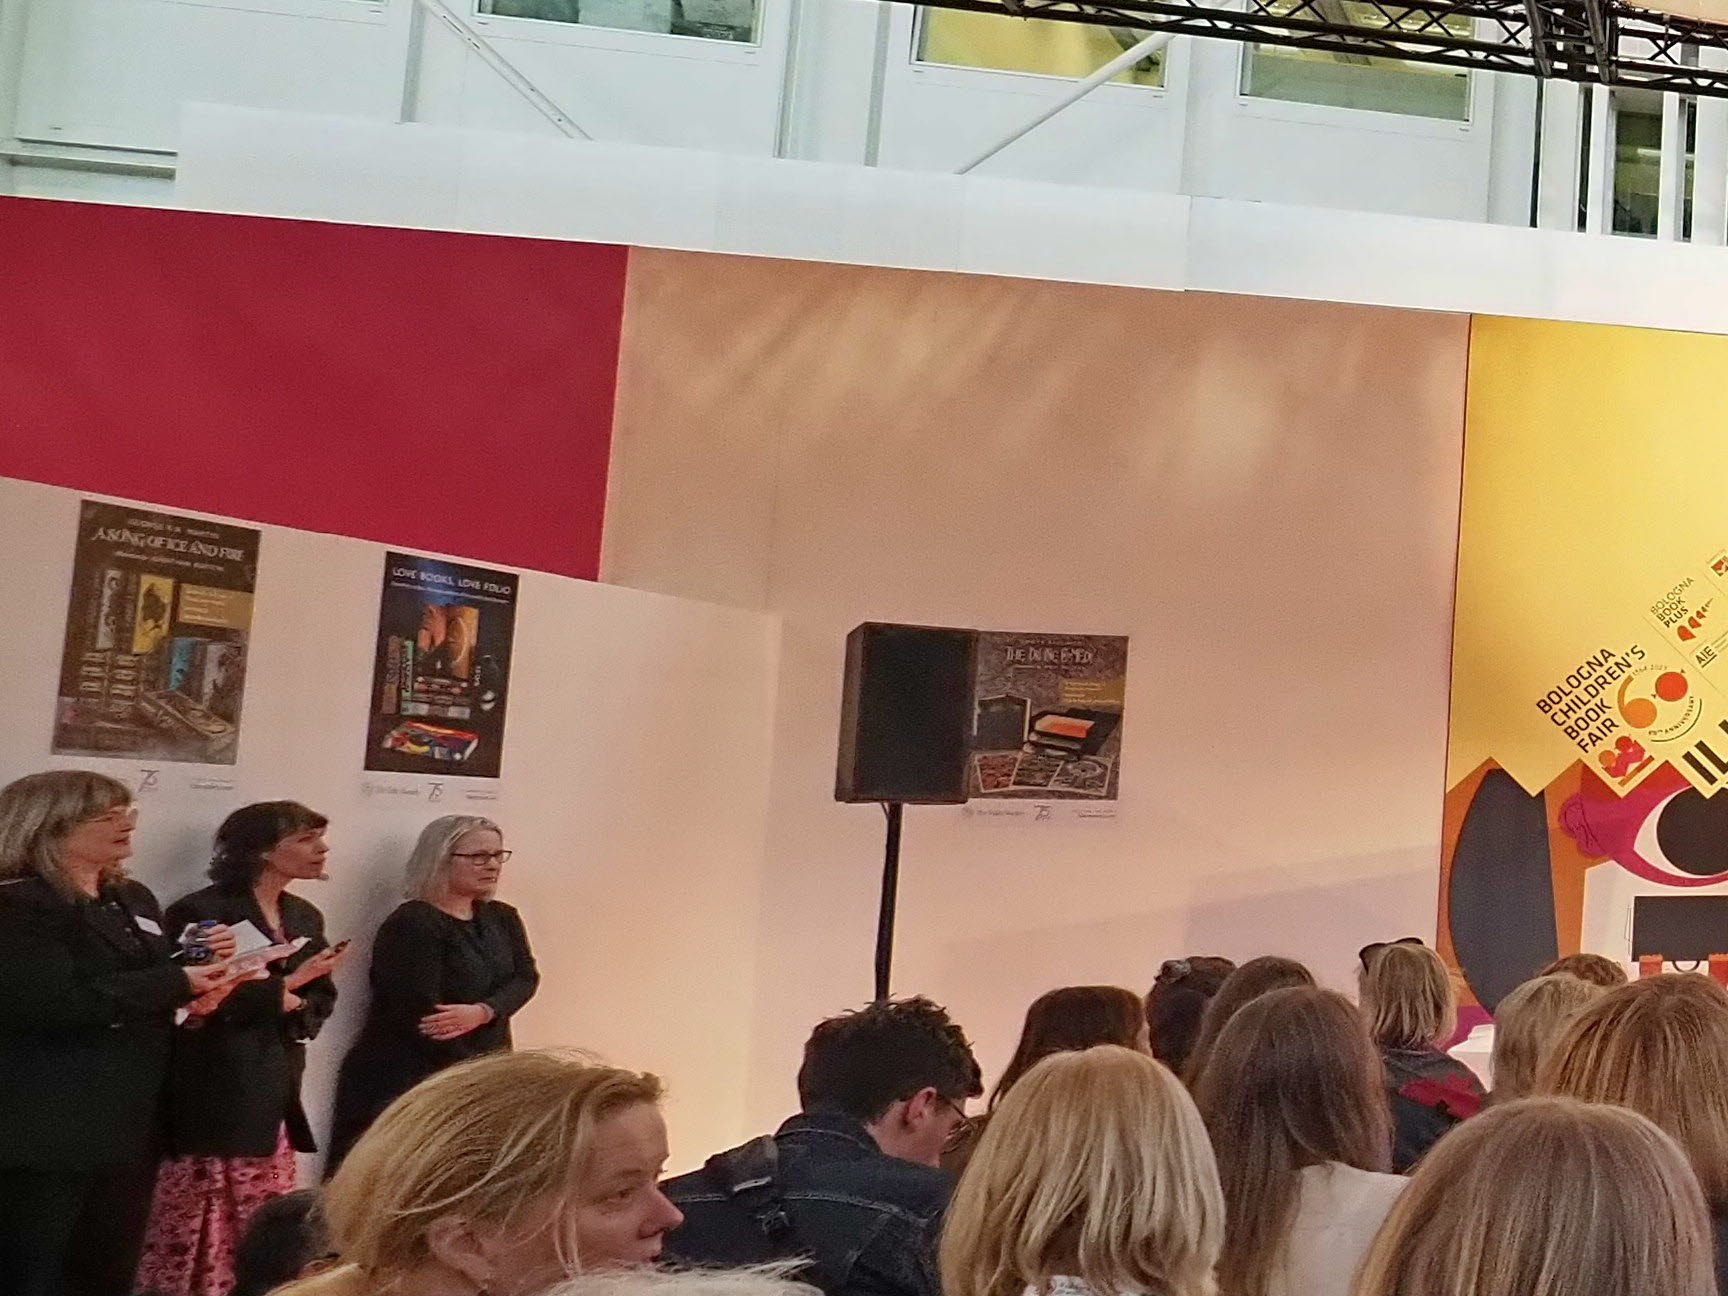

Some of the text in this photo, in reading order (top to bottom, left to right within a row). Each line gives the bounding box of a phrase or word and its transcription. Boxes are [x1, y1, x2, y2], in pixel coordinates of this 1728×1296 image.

[1650, 577, 1695, 615] BOLOGNA
[1656, 596, 1686, 622] BOOK
[1663, 607, 1689, 629] PLUS
[1536, 648, 1616, 714] BOLOGNA
[1550, 644, 1646, 727] CHILDREN'S
[1563, 697, 1614, 740] BOOK
[1577, 717, 1620, 754] FAIR
